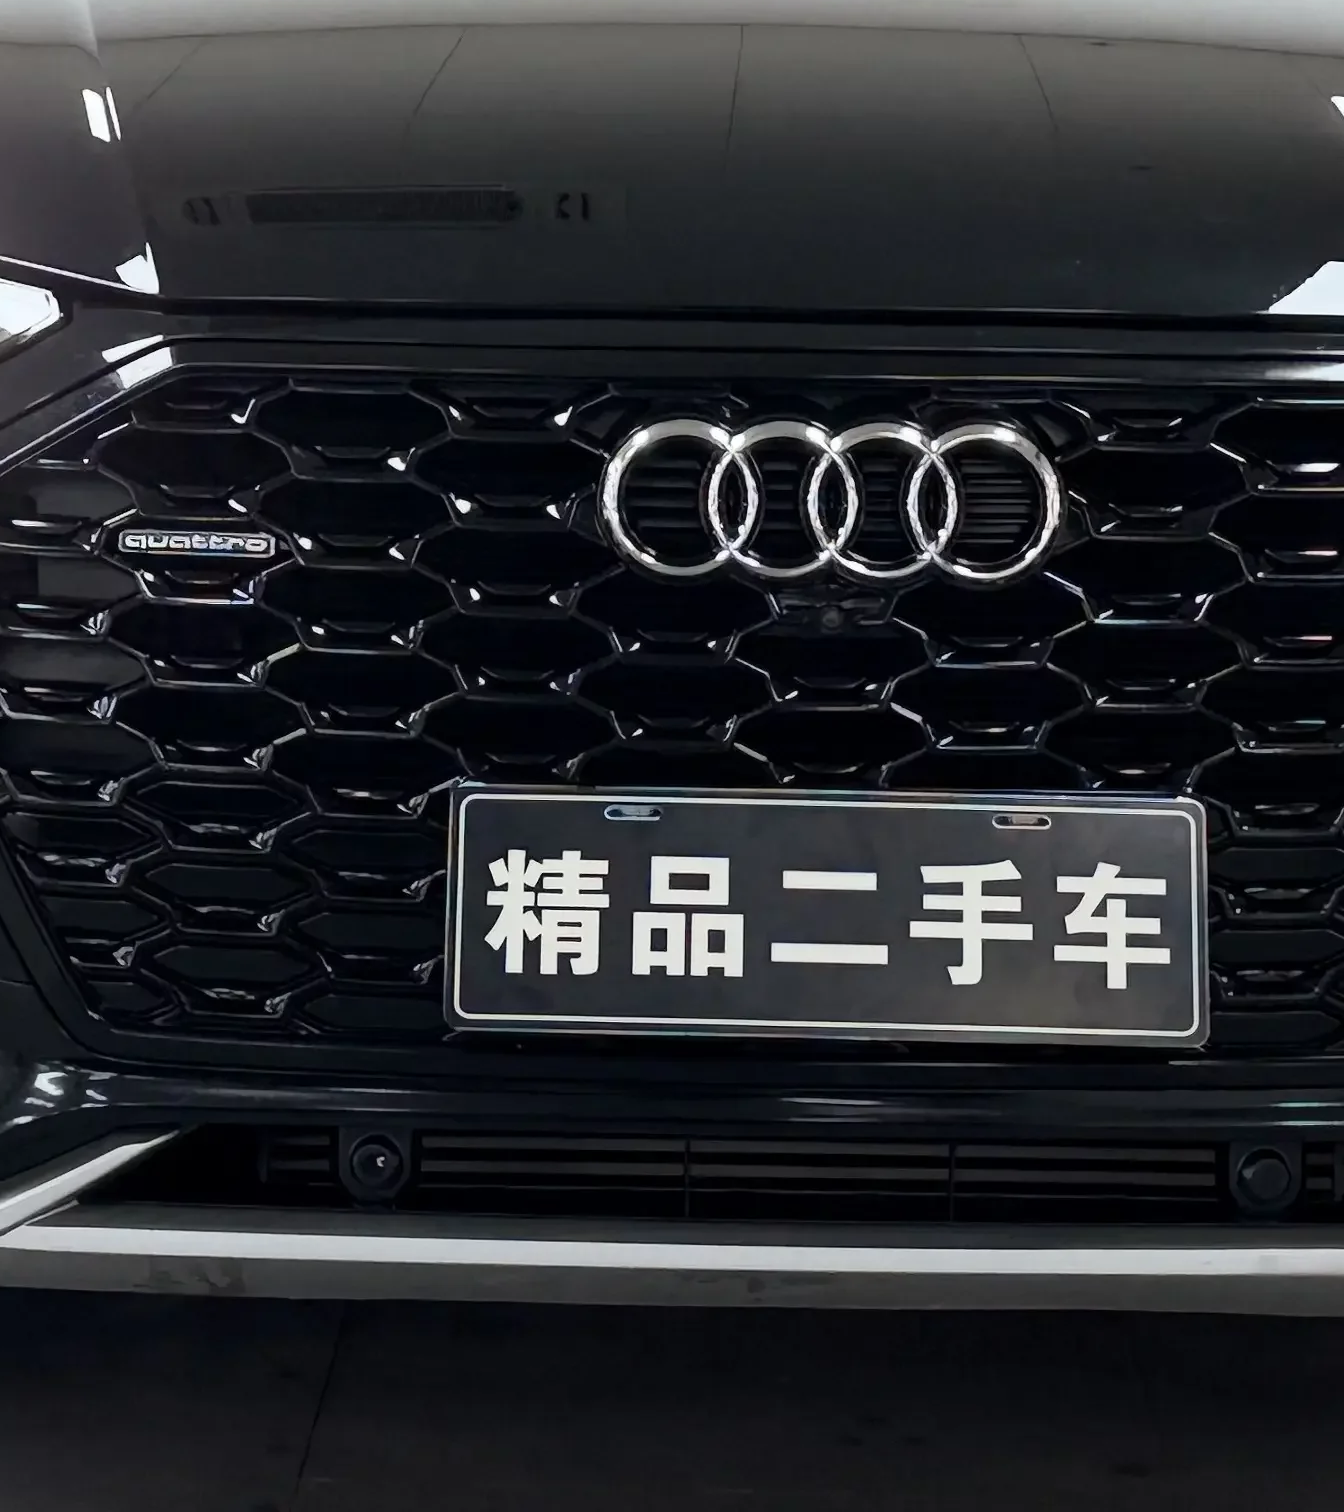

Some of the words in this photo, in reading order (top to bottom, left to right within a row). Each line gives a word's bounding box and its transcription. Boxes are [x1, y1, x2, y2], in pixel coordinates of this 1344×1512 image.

[124, 533, 269, 552] quattro
[484, 849, 1172, 990] 精品二手车
